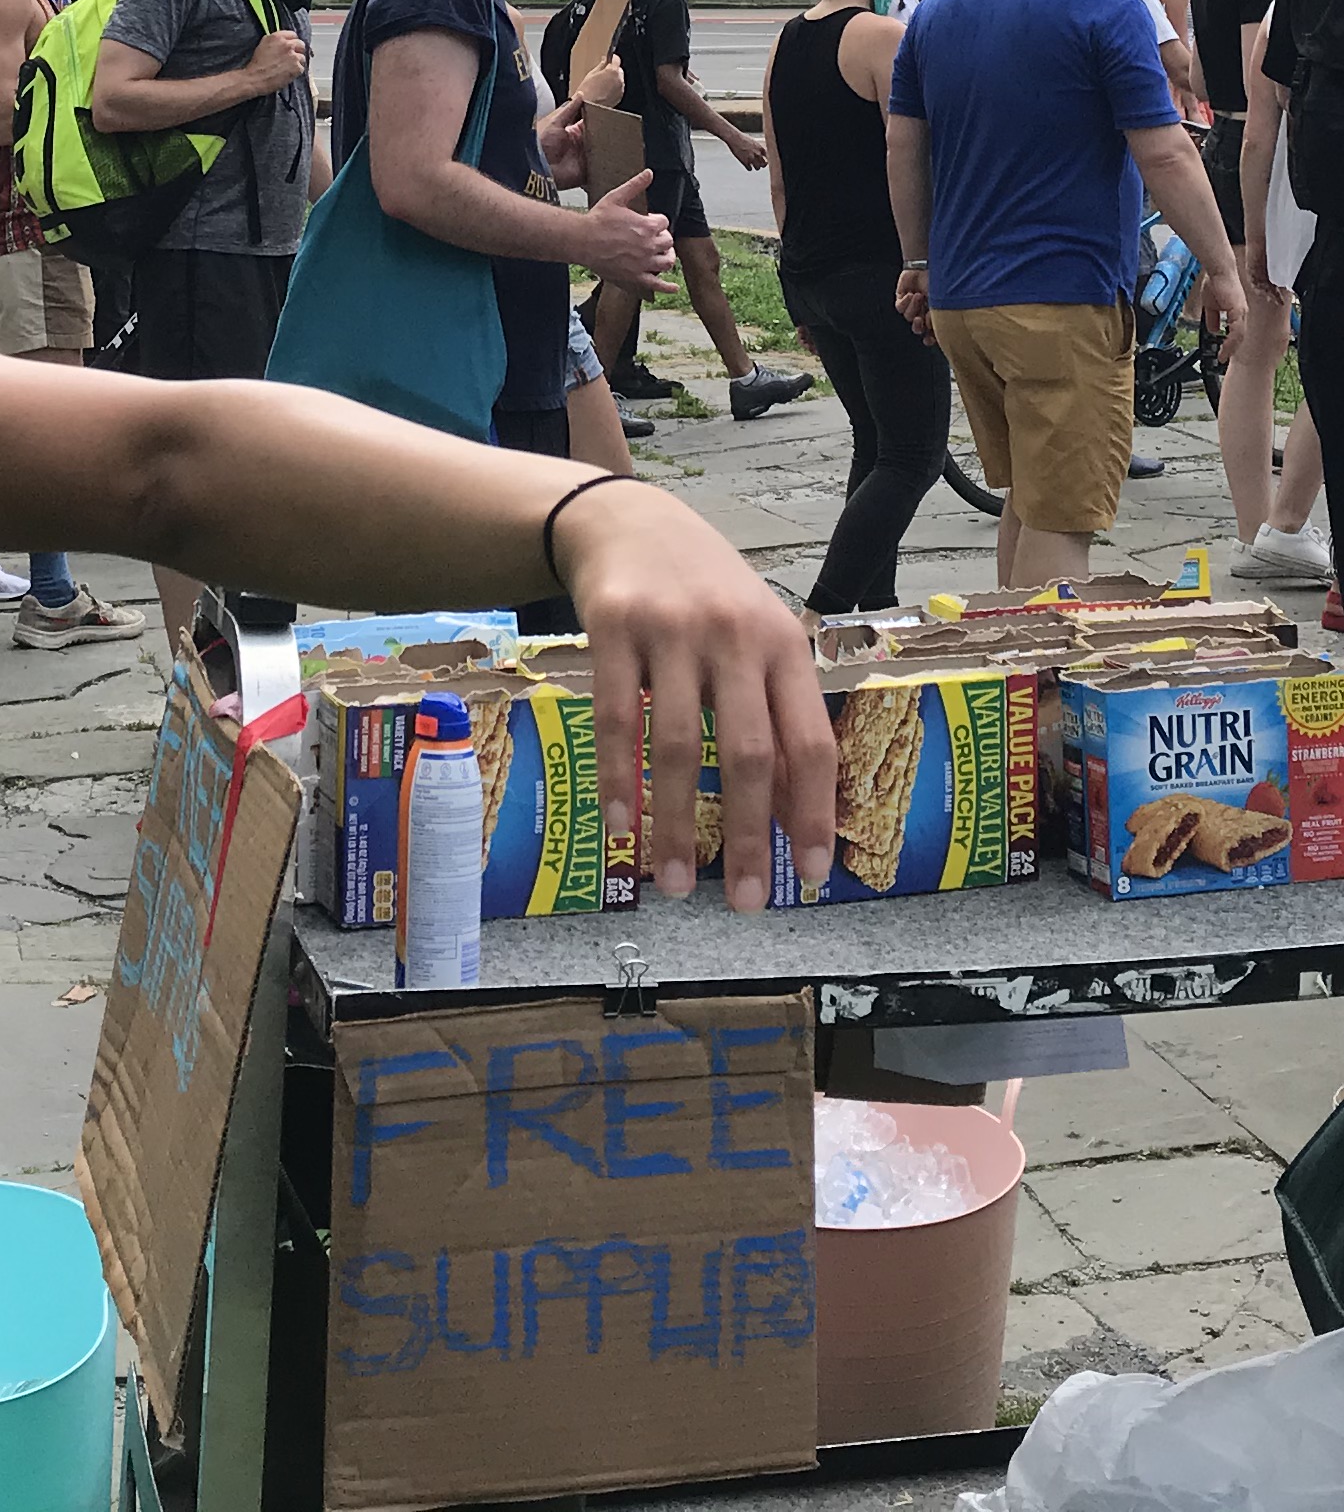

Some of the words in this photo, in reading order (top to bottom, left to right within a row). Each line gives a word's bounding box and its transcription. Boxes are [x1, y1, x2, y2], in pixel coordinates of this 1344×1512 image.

[1176, 692, 1223, 709] Kellogg's
[1293, 679, 1344, 691] MORNING
[395, 715, 405, 747] VARIETY
[968, 687, 1001, 786] NATURE
[1009, 687, 1035, 771] VALUE
[1148, 709, 1252, 754] NUTRI
[394, 749, 403, 770] PACK
[1148, 740, 1255, 783] GRAIN
[953, 724, 973, 849] CRUNCHY
[1170, 782, 1194, 790] BAKED
[543, 742, 568, 874] CRUNCHY
[1010, 773, 1035, 842] PACK
[608, 831, 636, 868] CK
[968, 787, 1002, 876] VALLEY
[560, 809, 599, 903] VALLEY
[1010, 851, 1020, 876] BARS
[1019, 850, 1035, 875] 24
[606, 878, 618, 904] BARS
[619, 877, 635, 903] 24
[1117, 876, 1131, 894] 8
[349, 1024, 805, 1206] FREE
